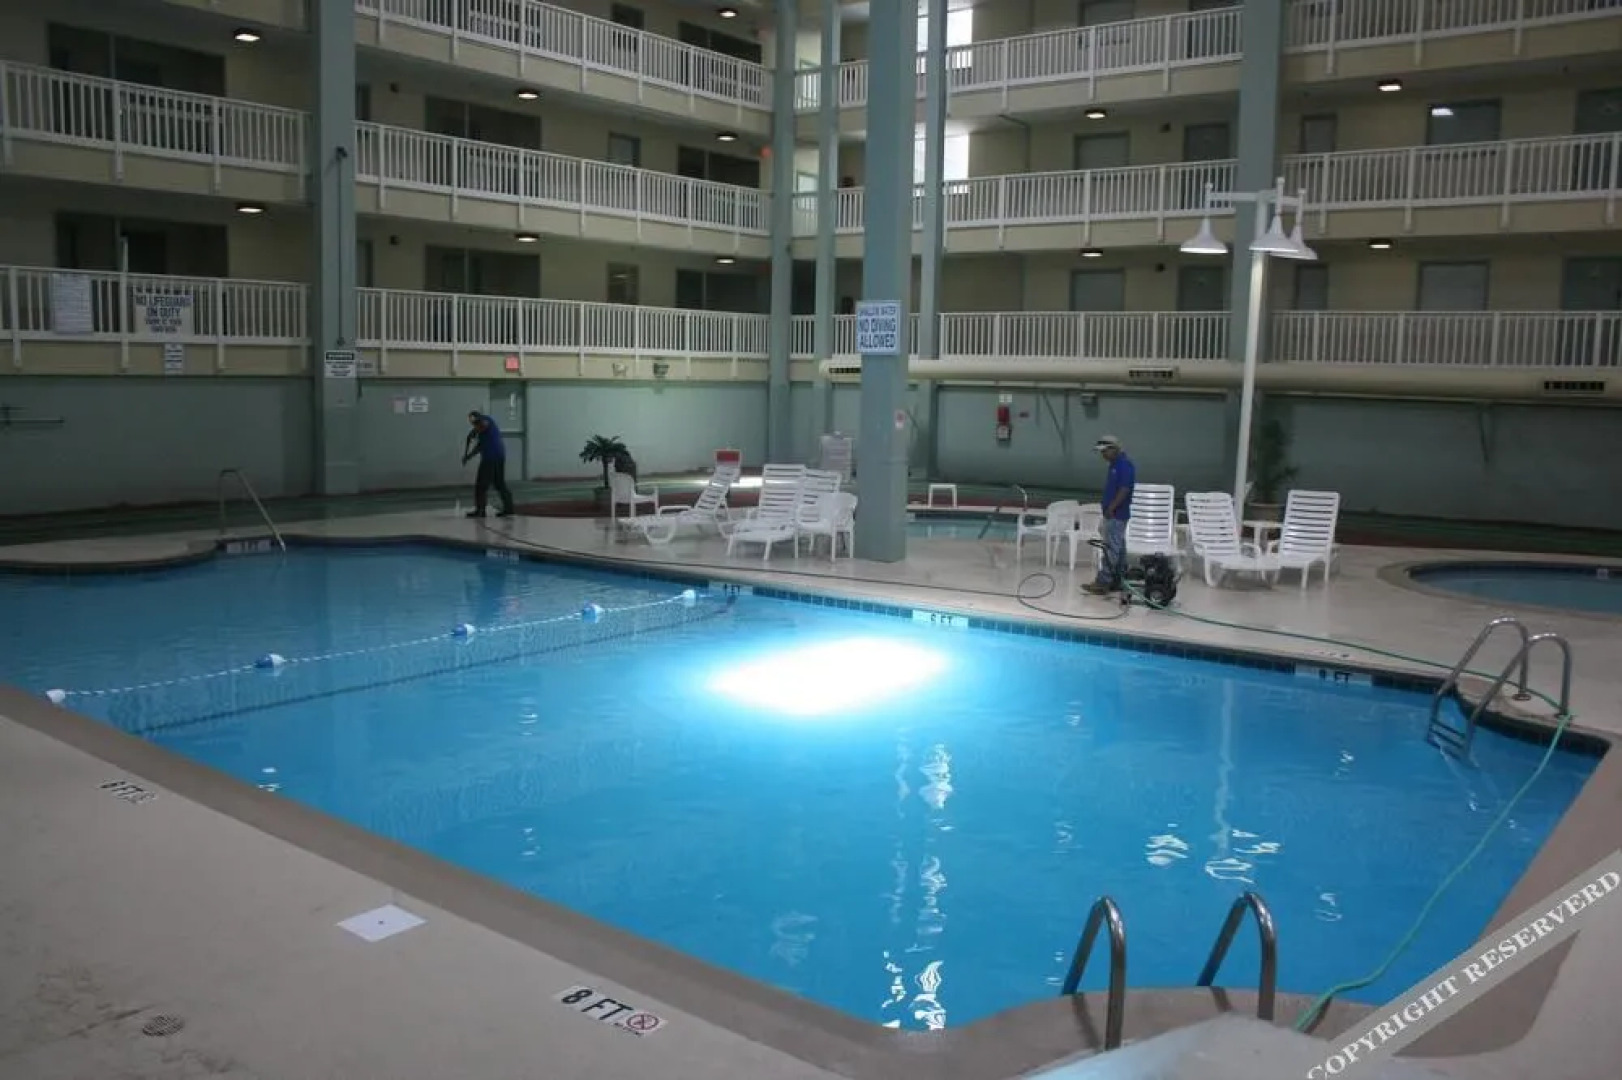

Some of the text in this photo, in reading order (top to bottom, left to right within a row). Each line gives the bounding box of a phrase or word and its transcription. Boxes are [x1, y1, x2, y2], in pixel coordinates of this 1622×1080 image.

[147, 307, 181, 317] ON DUTY
[860, 317, 896, 332] NO DIVING
[861, 333, 896, 348] ALLOWED
[940, 615, 953, 624] FT
[1334, 671, 1351, 684] FT
[111, 785, 144, 798] FT
[561, 989, 634, 1021] 8 FT
